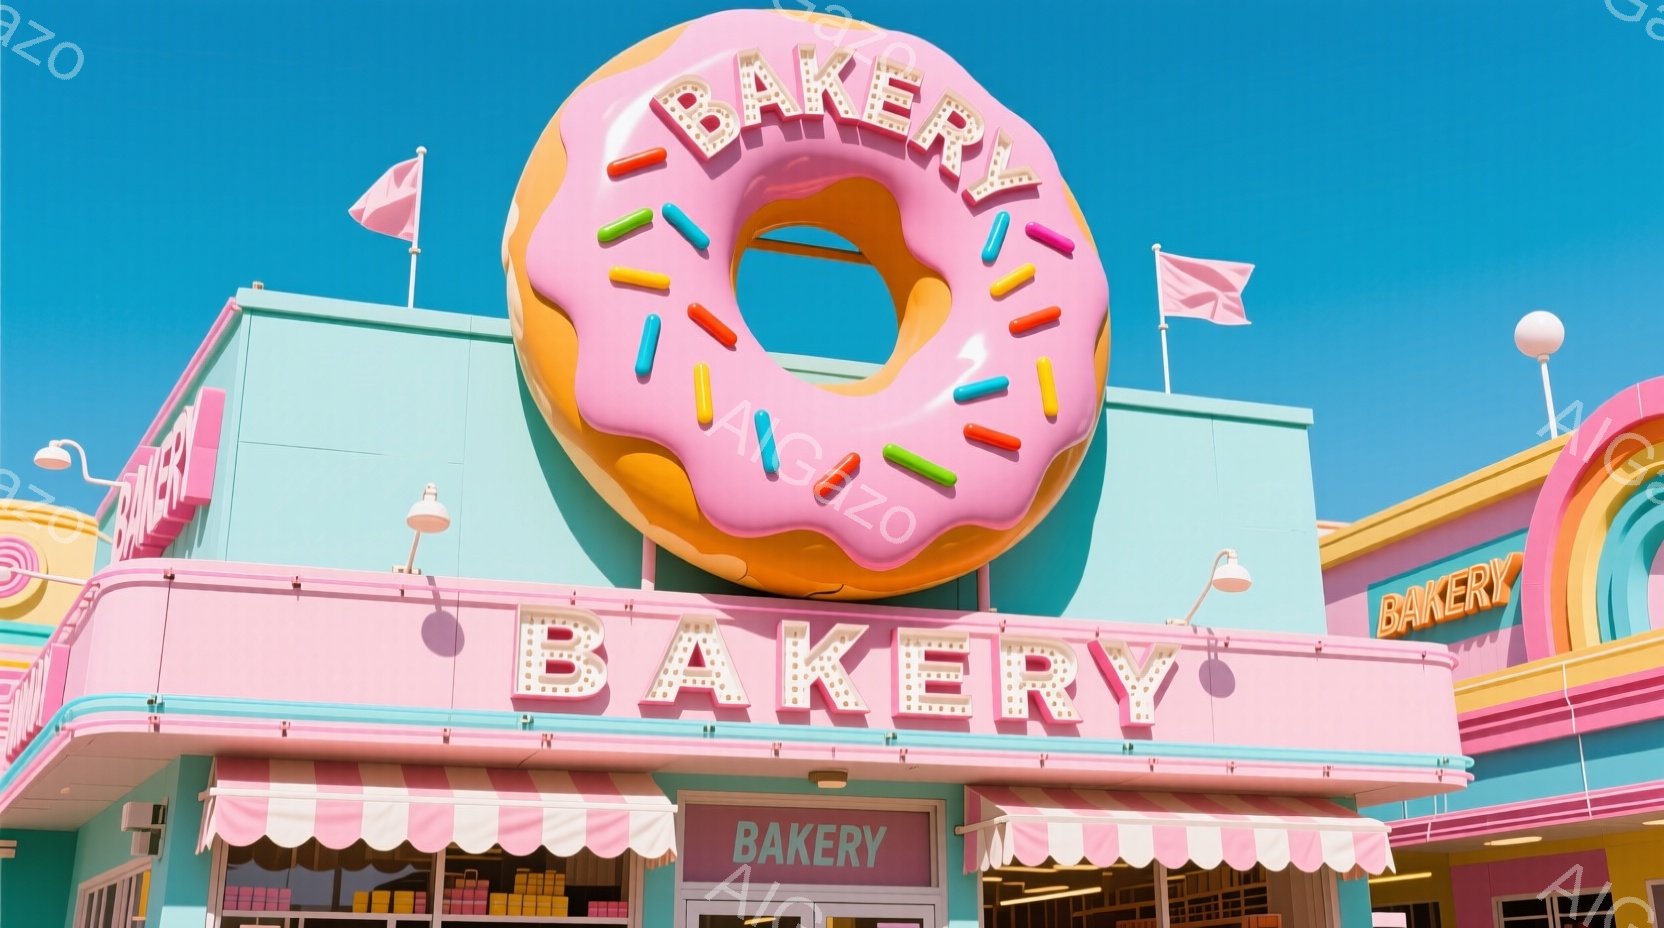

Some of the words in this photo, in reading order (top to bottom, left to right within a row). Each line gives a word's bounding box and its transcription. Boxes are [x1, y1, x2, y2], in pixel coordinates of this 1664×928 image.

[649, 43, 1042, 207] BAKERY
[1377, 552, 1524, 638] BAKERY
[511, 603, 1182, 727] BAKERY
[732, 821, 888, 868] BAKERY
